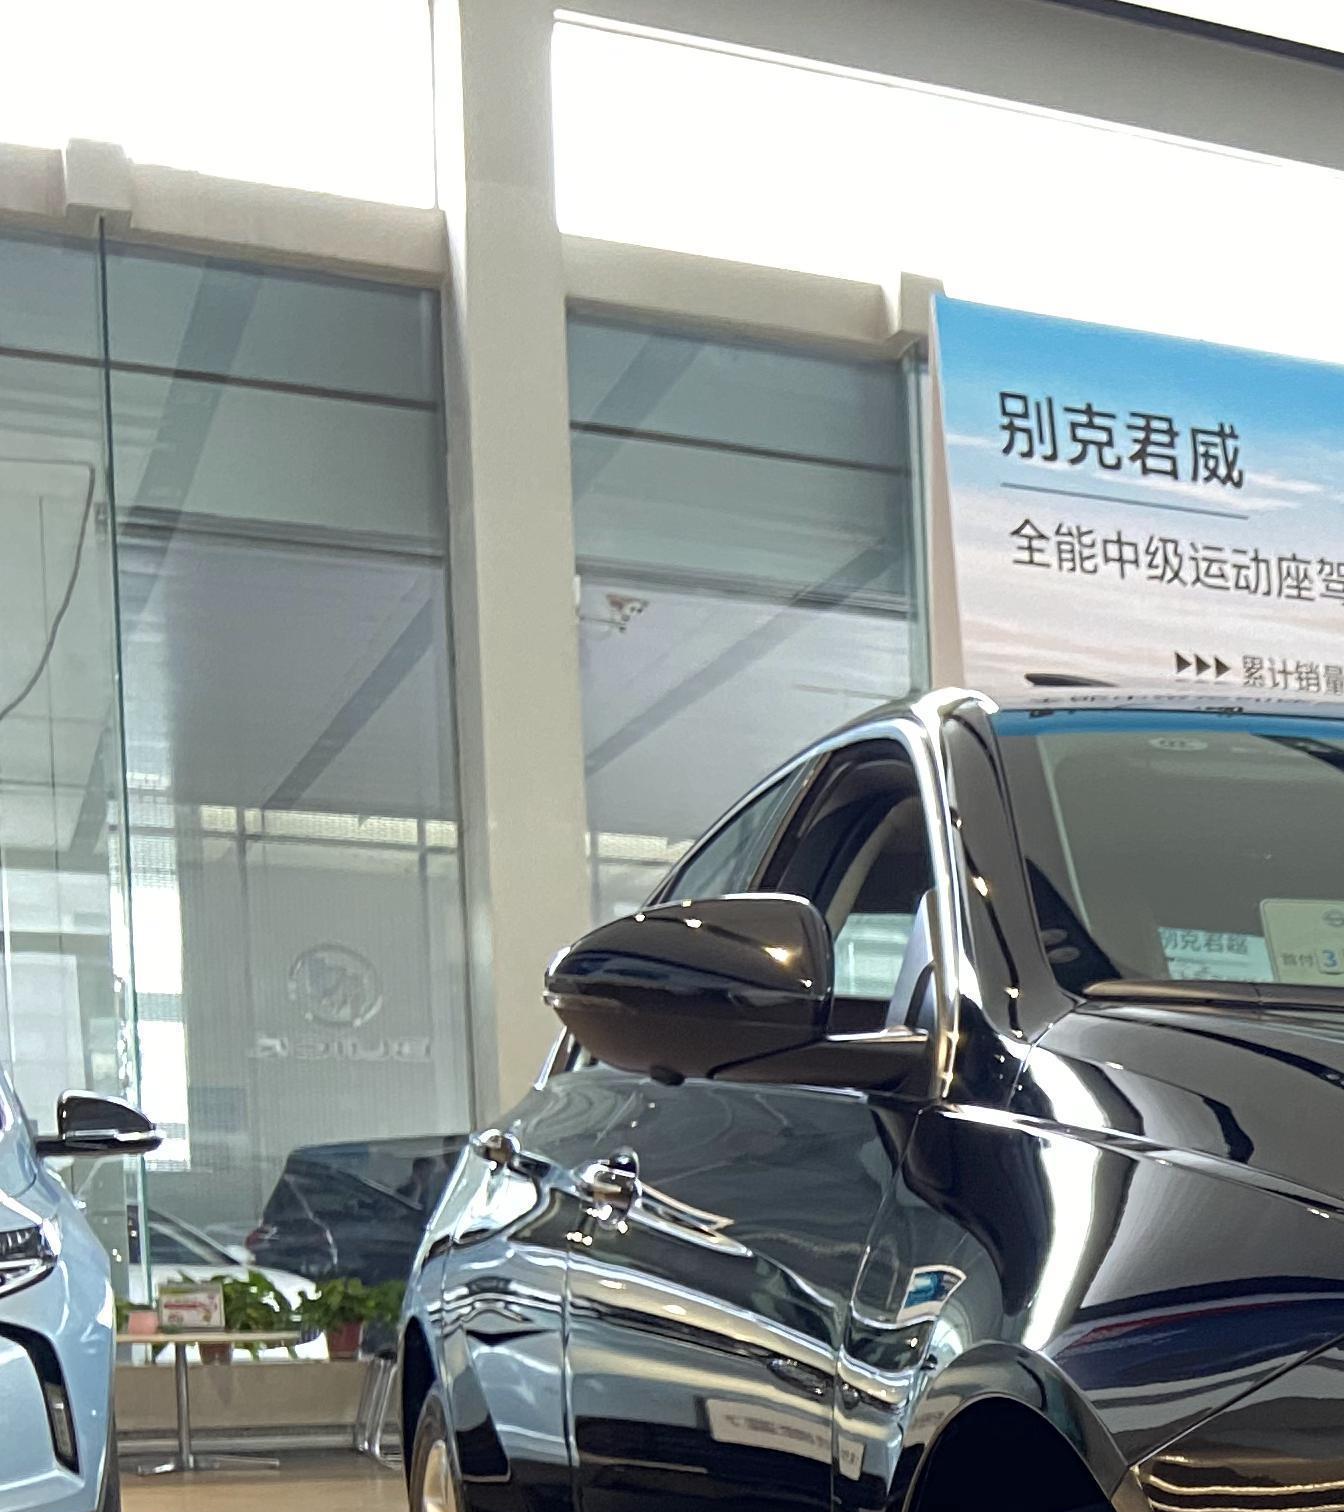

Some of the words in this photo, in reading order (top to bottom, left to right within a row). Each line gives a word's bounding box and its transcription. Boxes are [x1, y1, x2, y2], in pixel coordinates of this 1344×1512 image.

[999, 391, 1245, 489] 别克君威
[1241, 654, 1344, 696] 累计销量
